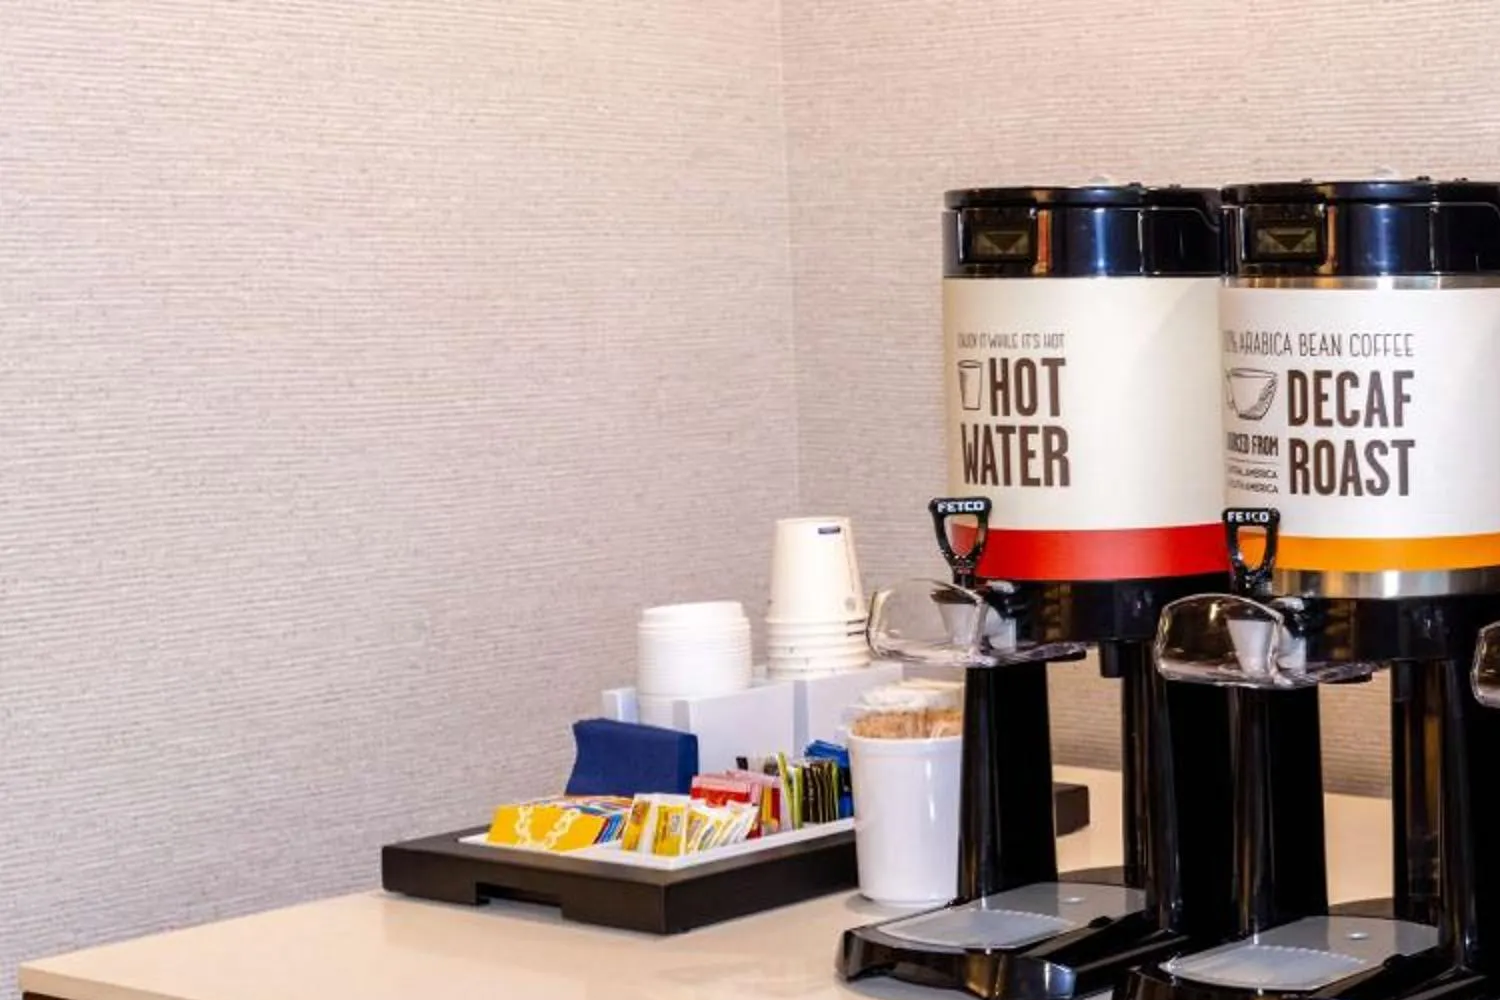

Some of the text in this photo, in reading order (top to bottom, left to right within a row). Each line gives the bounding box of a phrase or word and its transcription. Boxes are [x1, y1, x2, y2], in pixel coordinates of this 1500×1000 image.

[1239, 331, 1293, 357] ARABICA
[1299, 332, 1342, 357] BEAN
[1349, 333, 1414, 357] COFFEE
[989, 357, 1066, 417] HOT
[1287, 369, 1415, 428] DECAF
[961, 424, 1070, 487] WATER
[1251, 434, 1279, 456] FROM
[1289, 438, 1416, 497] ROAST
[937, 501, 985, 513] FETCO
[1227, 511, 1269, 523] FETCO
